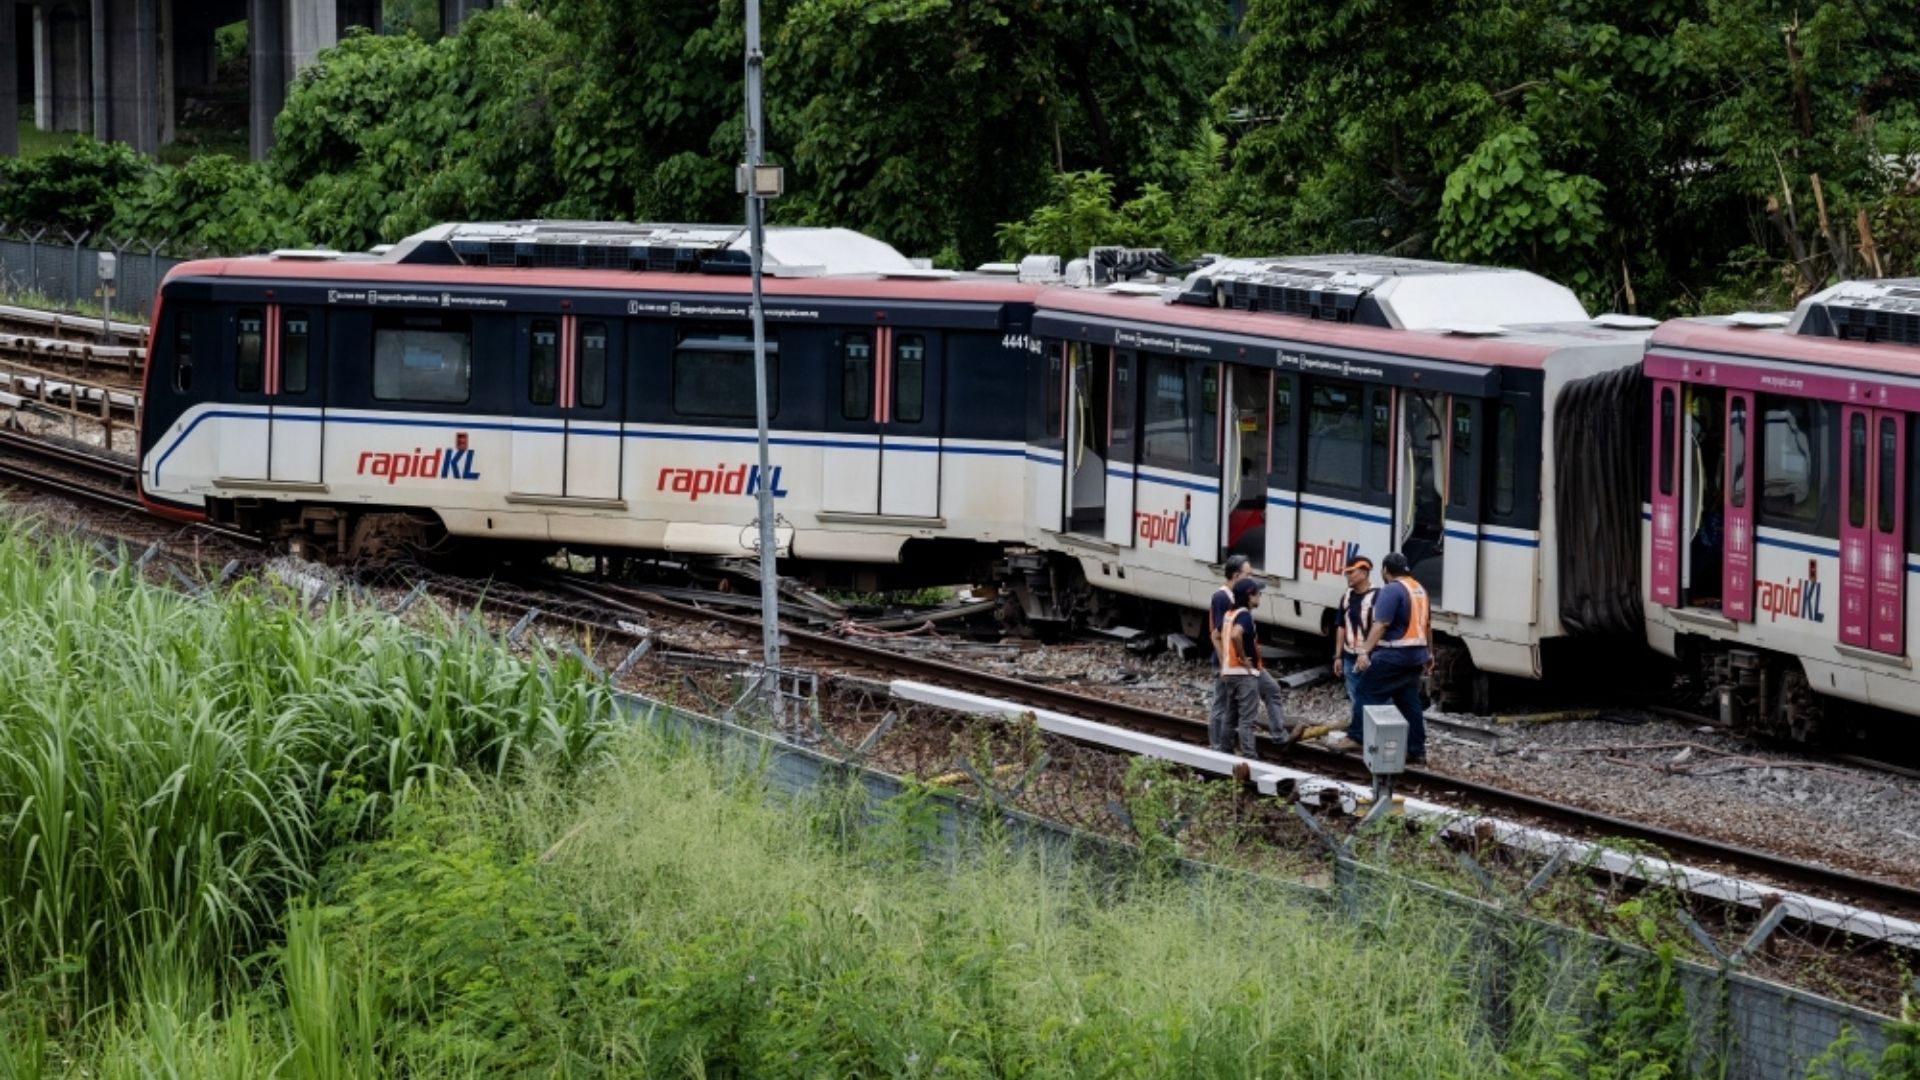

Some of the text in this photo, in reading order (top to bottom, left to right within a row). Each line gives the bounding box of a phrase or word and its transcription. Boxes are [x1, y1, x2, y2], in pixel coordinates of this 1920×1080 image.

[1002, 334, 1028, 349] 4441
[357, 447, 480, 484] rapidKL
[1134, 509, 1190, 548] rapidK
[1755, 576, 1825, 623] rapidKL
